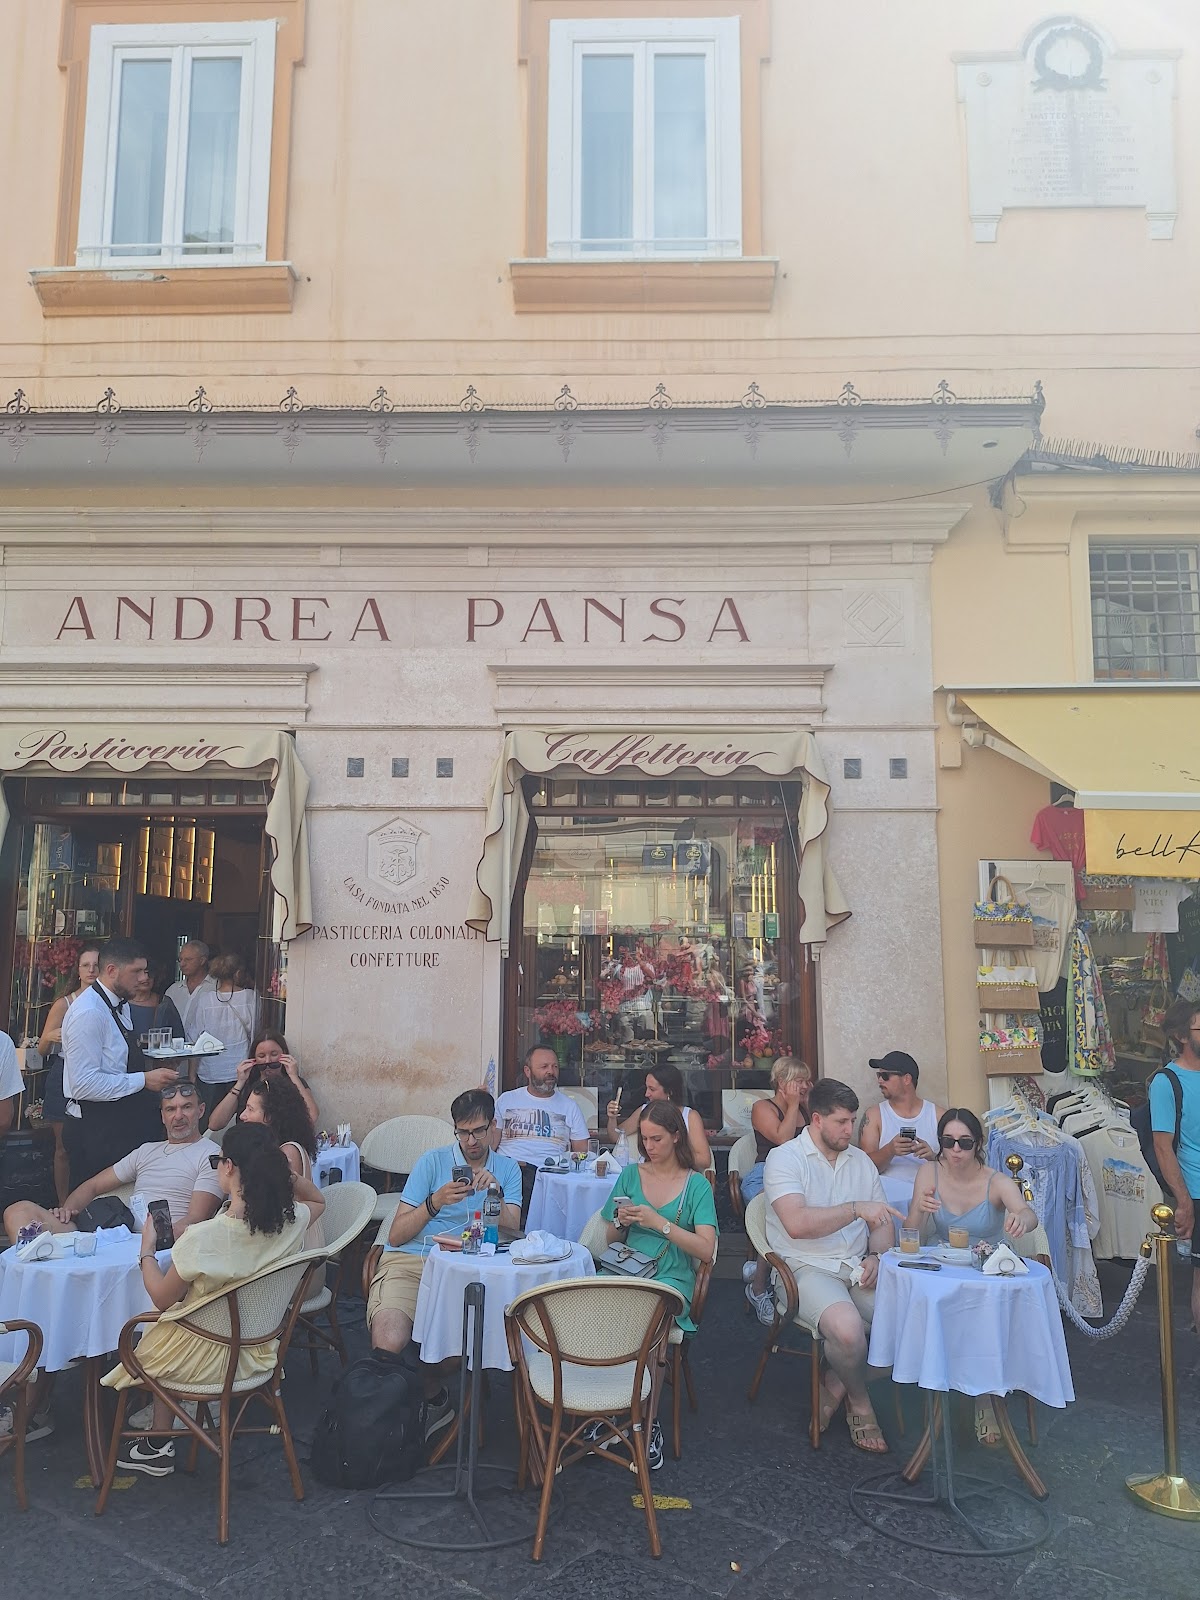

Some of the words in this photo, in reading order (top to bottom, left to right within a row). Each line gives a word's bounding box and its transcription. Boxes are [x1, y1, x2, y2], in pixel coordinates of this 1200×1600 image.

[54, 596, 392, 642] ANDREA
[466, 597, 752, 643] PANSA
[14, 729, 244, 760] Pasticceria
[544, 733, 778, 771] Caffetteria
[343, 876, 365, 903] CASA
[365, 896, 410, 914] FONDATA
[411, 896, 430, 911] NEL
[429, 876, 450, 899] 1830
[312, 925, 403, 941] PASTICCERIA
[350, 952, 440, 969] CONFETTURE
[510, 1122, 558, 1135] GUESS
